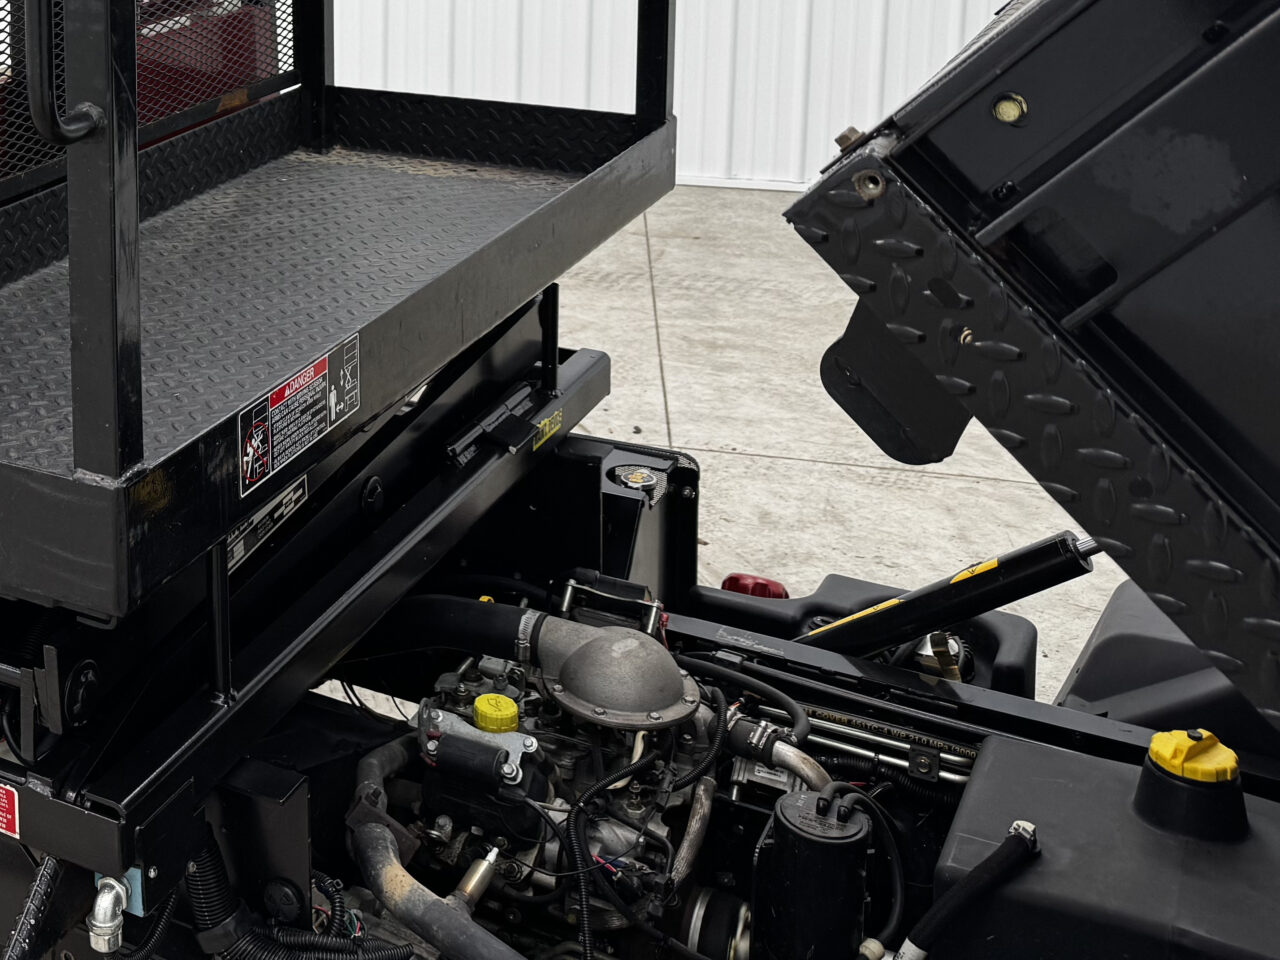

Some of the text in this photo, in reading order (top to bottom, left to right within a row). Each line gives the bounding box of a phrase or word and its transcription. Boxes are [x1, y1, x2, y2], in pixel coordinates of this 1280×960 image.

[290, 367, 315, 393] DANGER
[891, 729, 906, 738] WP
[930, 739, 949, 751] MPa
